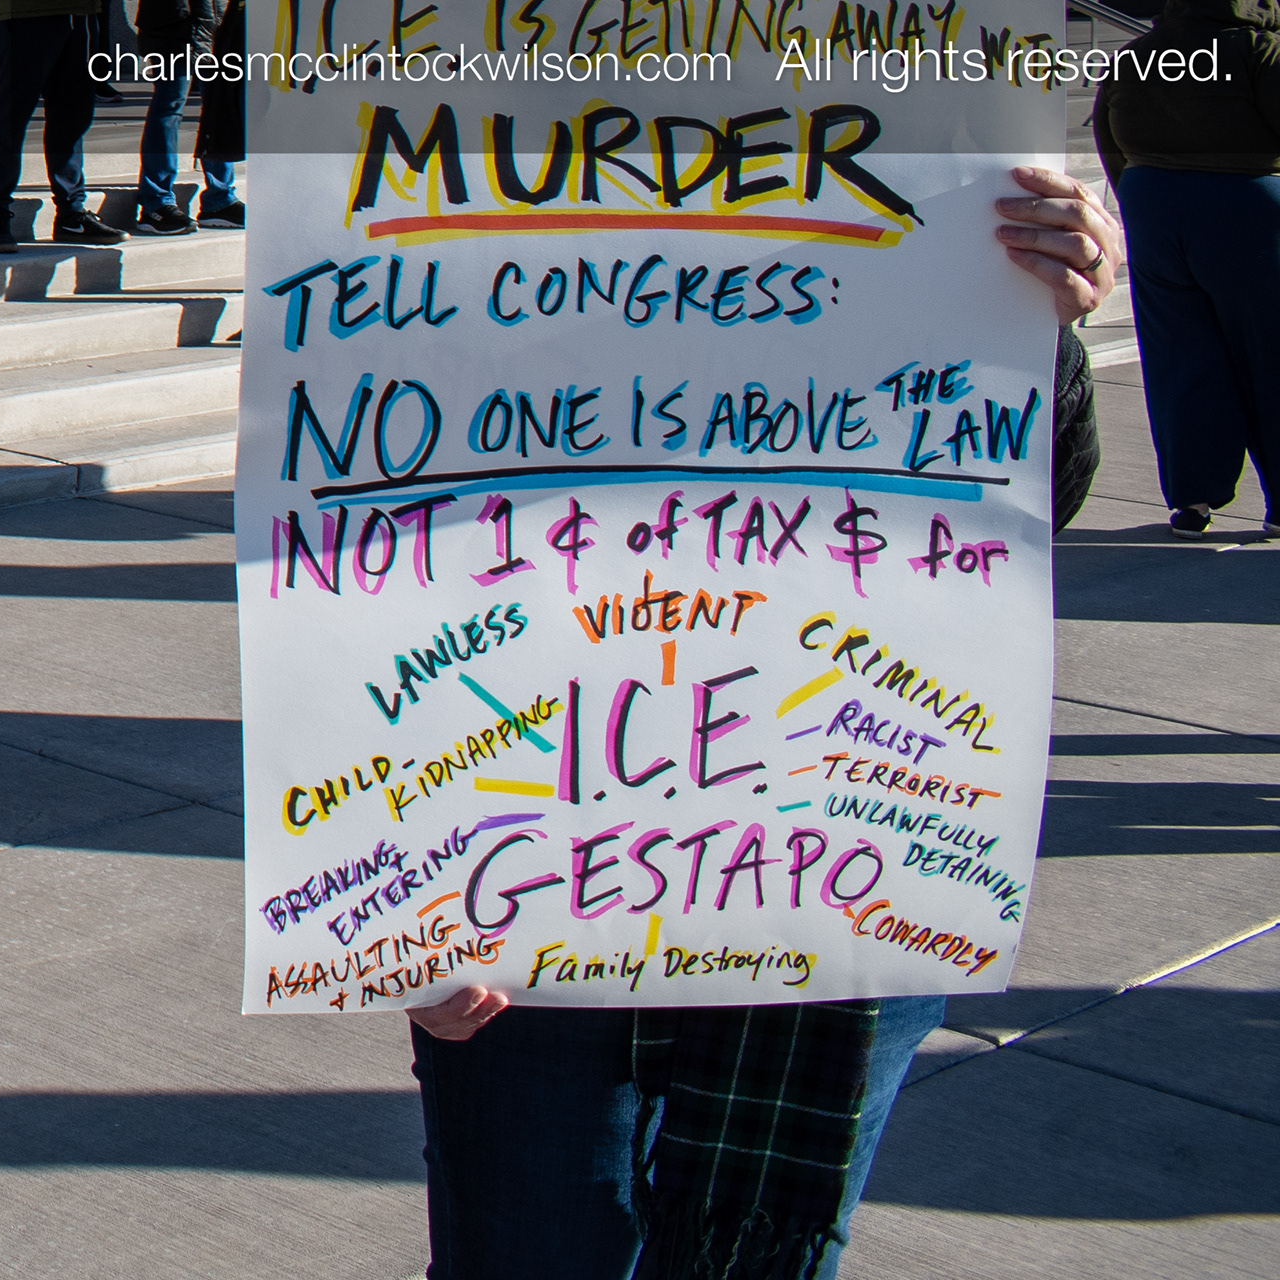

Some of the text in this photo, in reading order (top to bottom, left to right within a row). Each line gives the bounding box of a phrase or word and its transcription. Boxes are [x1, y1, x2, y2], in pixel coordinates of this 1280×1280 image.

[346, 102, 924, 226] MURDER
[263, 254, 839, 351] TELL CONGRESS:
[281, 359, 1041, 481] NO ONE IS ABOVE THE LAW
[269, 494, 460, 597] NOT
[470, 494, 535, 586] 1
[626, 490, 688, 559] of
[693, 490, 810, 571] TAX
[826, 485, 888, 598] $
[907, 512, 1009, 587] for
[366, 602, 529, 725] LAWLESS
[798, 610, 1001, 754] CRIMINAL
[383, 694, 565, 822] KIDNAPPING
[558, 665, 768, 805] I.C.E.
[822, 752, 1002, 810] TERRORIST
[825, 699, 947, 766] RACIST
[824, 792, 999, 858] UNLAWFULLY
[328, 827, 479, 946] ENTERING
[465, 820, 883, 939] GESTAPO
[902, 841, 1026, 924] DETAINING
[267, 915, 461, 1003] ASSAULTING
[360, 936, 506, 1008] INJURING
[526, 941, 818, 992] Family Destroying
[851, 899, 999, 977] COWARDLY
